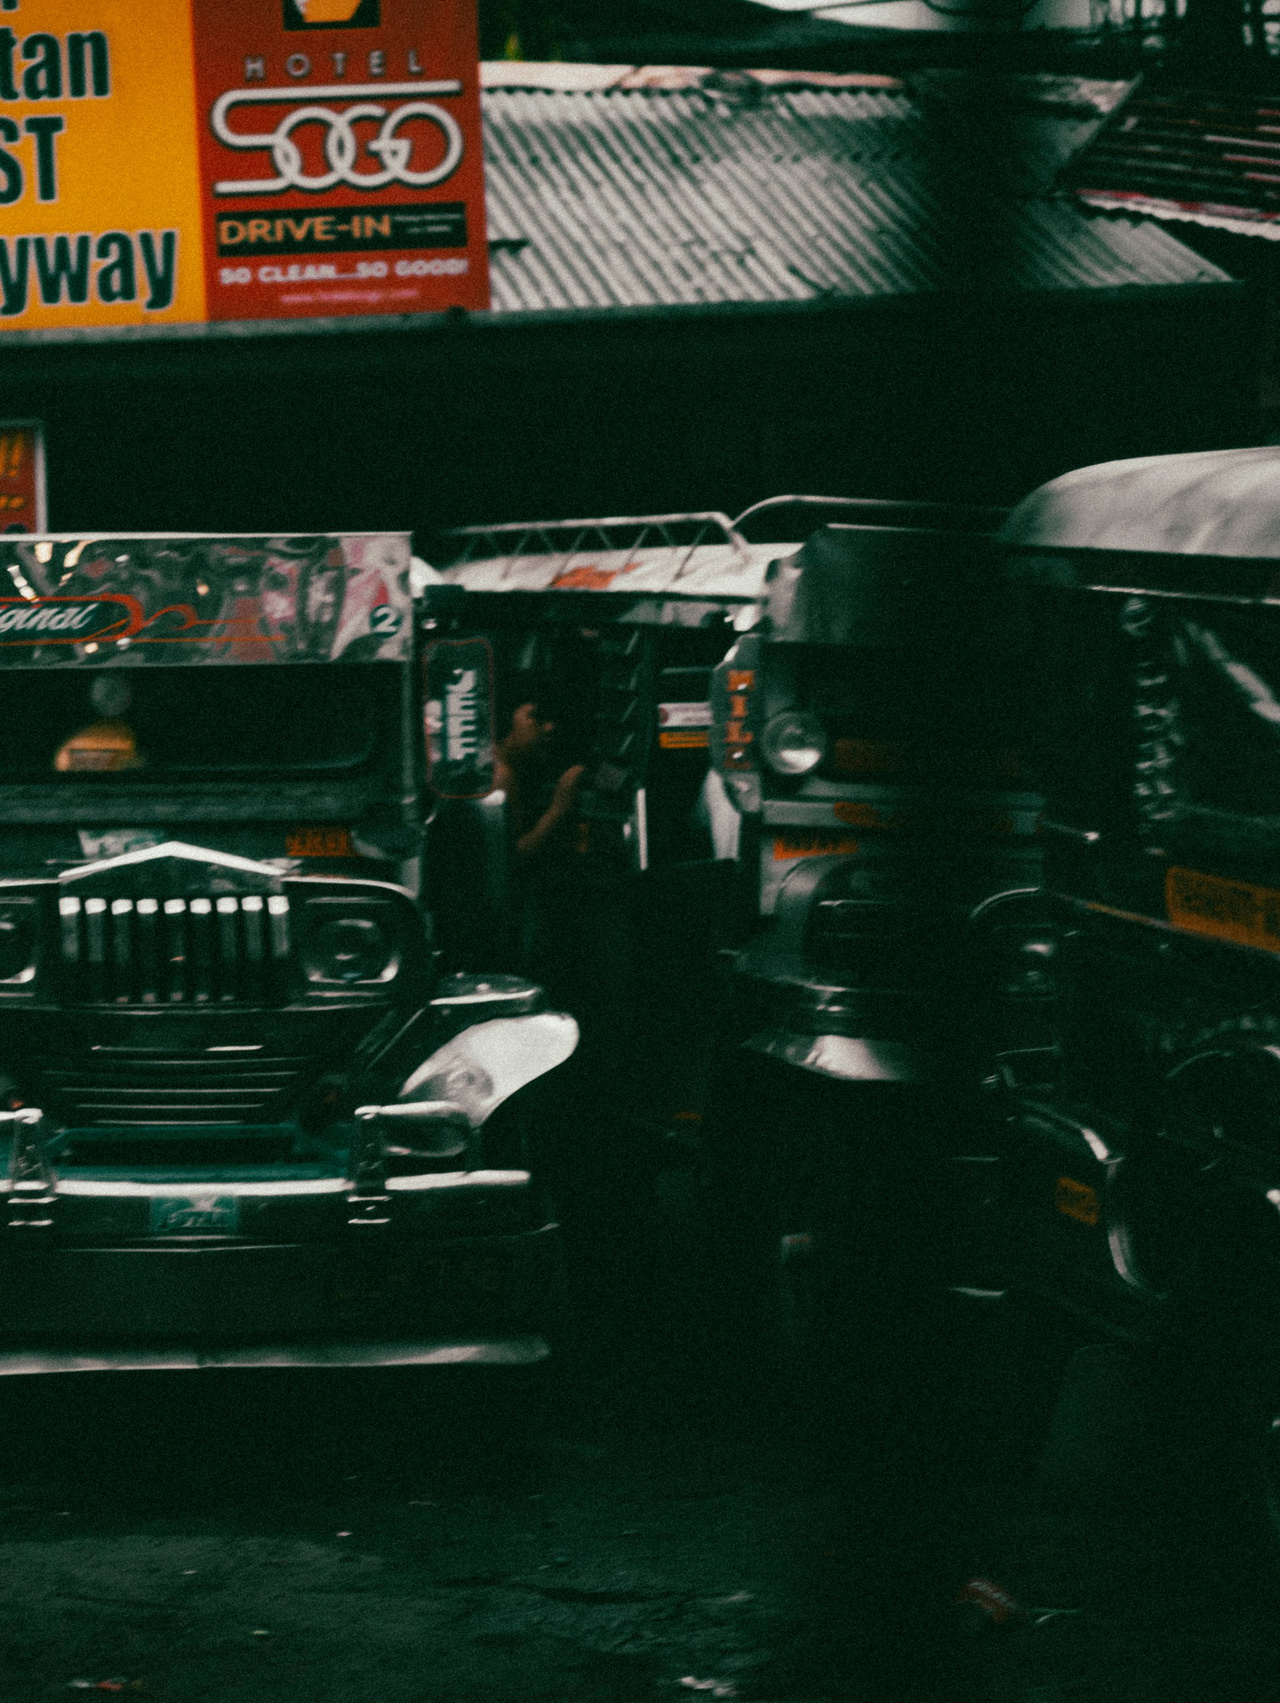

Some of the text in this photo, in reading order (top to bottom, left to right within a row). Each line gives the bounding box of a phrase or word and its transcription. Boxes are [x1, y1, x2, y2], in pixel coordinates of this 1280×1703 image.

[245, 50, 423, 79] HOTEL
[210, 80, 463, 198] SOGO
[219, 215, 392, 244] DRIVE-IN
[373, 606, 398, 632] 2
